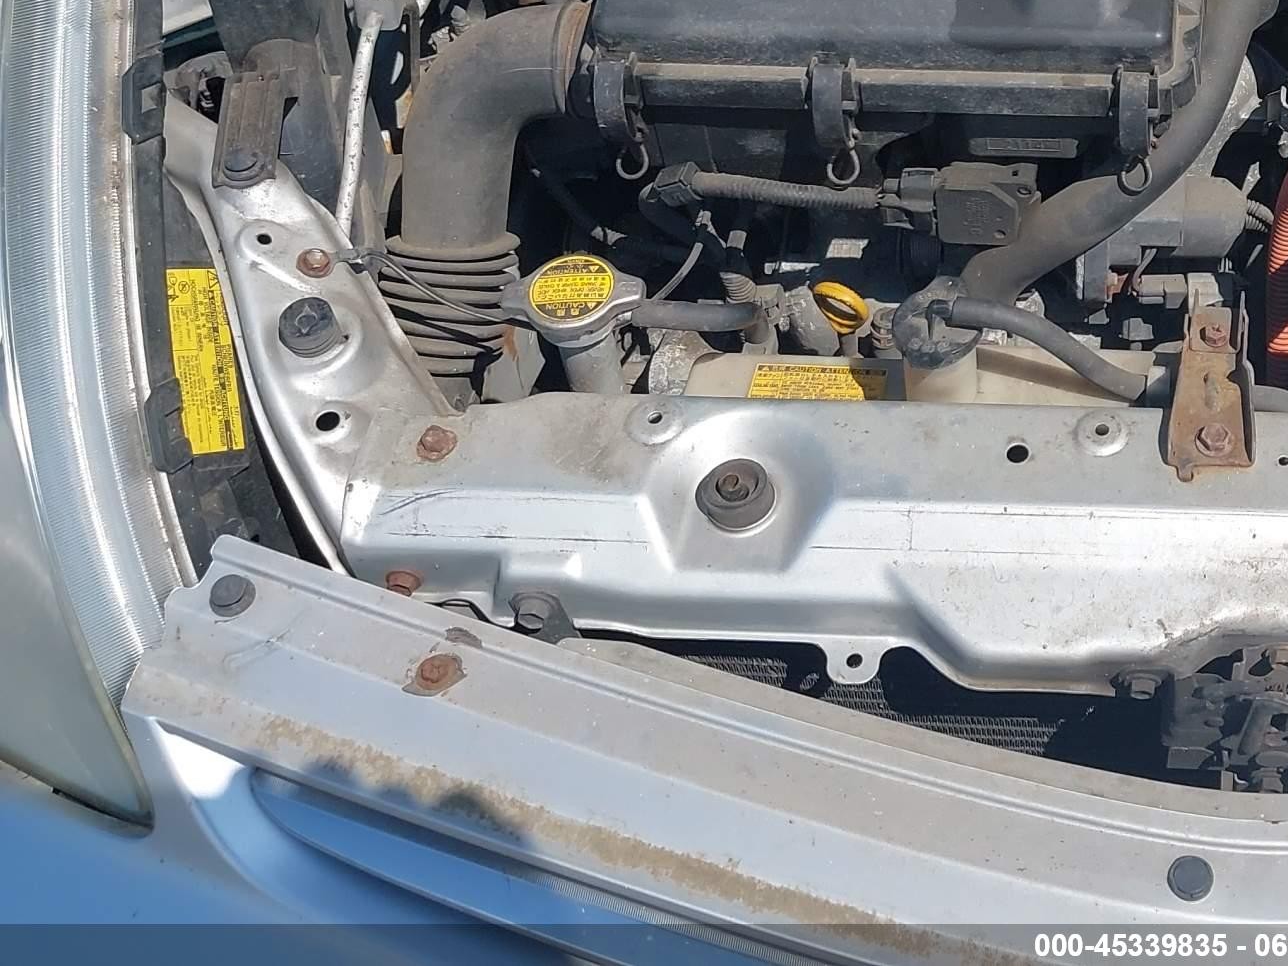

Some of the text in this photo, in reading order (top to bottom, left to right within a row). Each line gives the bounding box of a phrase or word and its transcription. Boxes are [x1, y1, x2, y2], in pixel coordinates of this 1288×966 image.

[210, 299, 218, 324] CAUTION
[545, 302, 585, 311] CAUTION
[213, 331, 223, 368] ATTENTION
[789, 365, 821, 373] CAUTION
[221, 389, 229, 421] ACHTUNG
